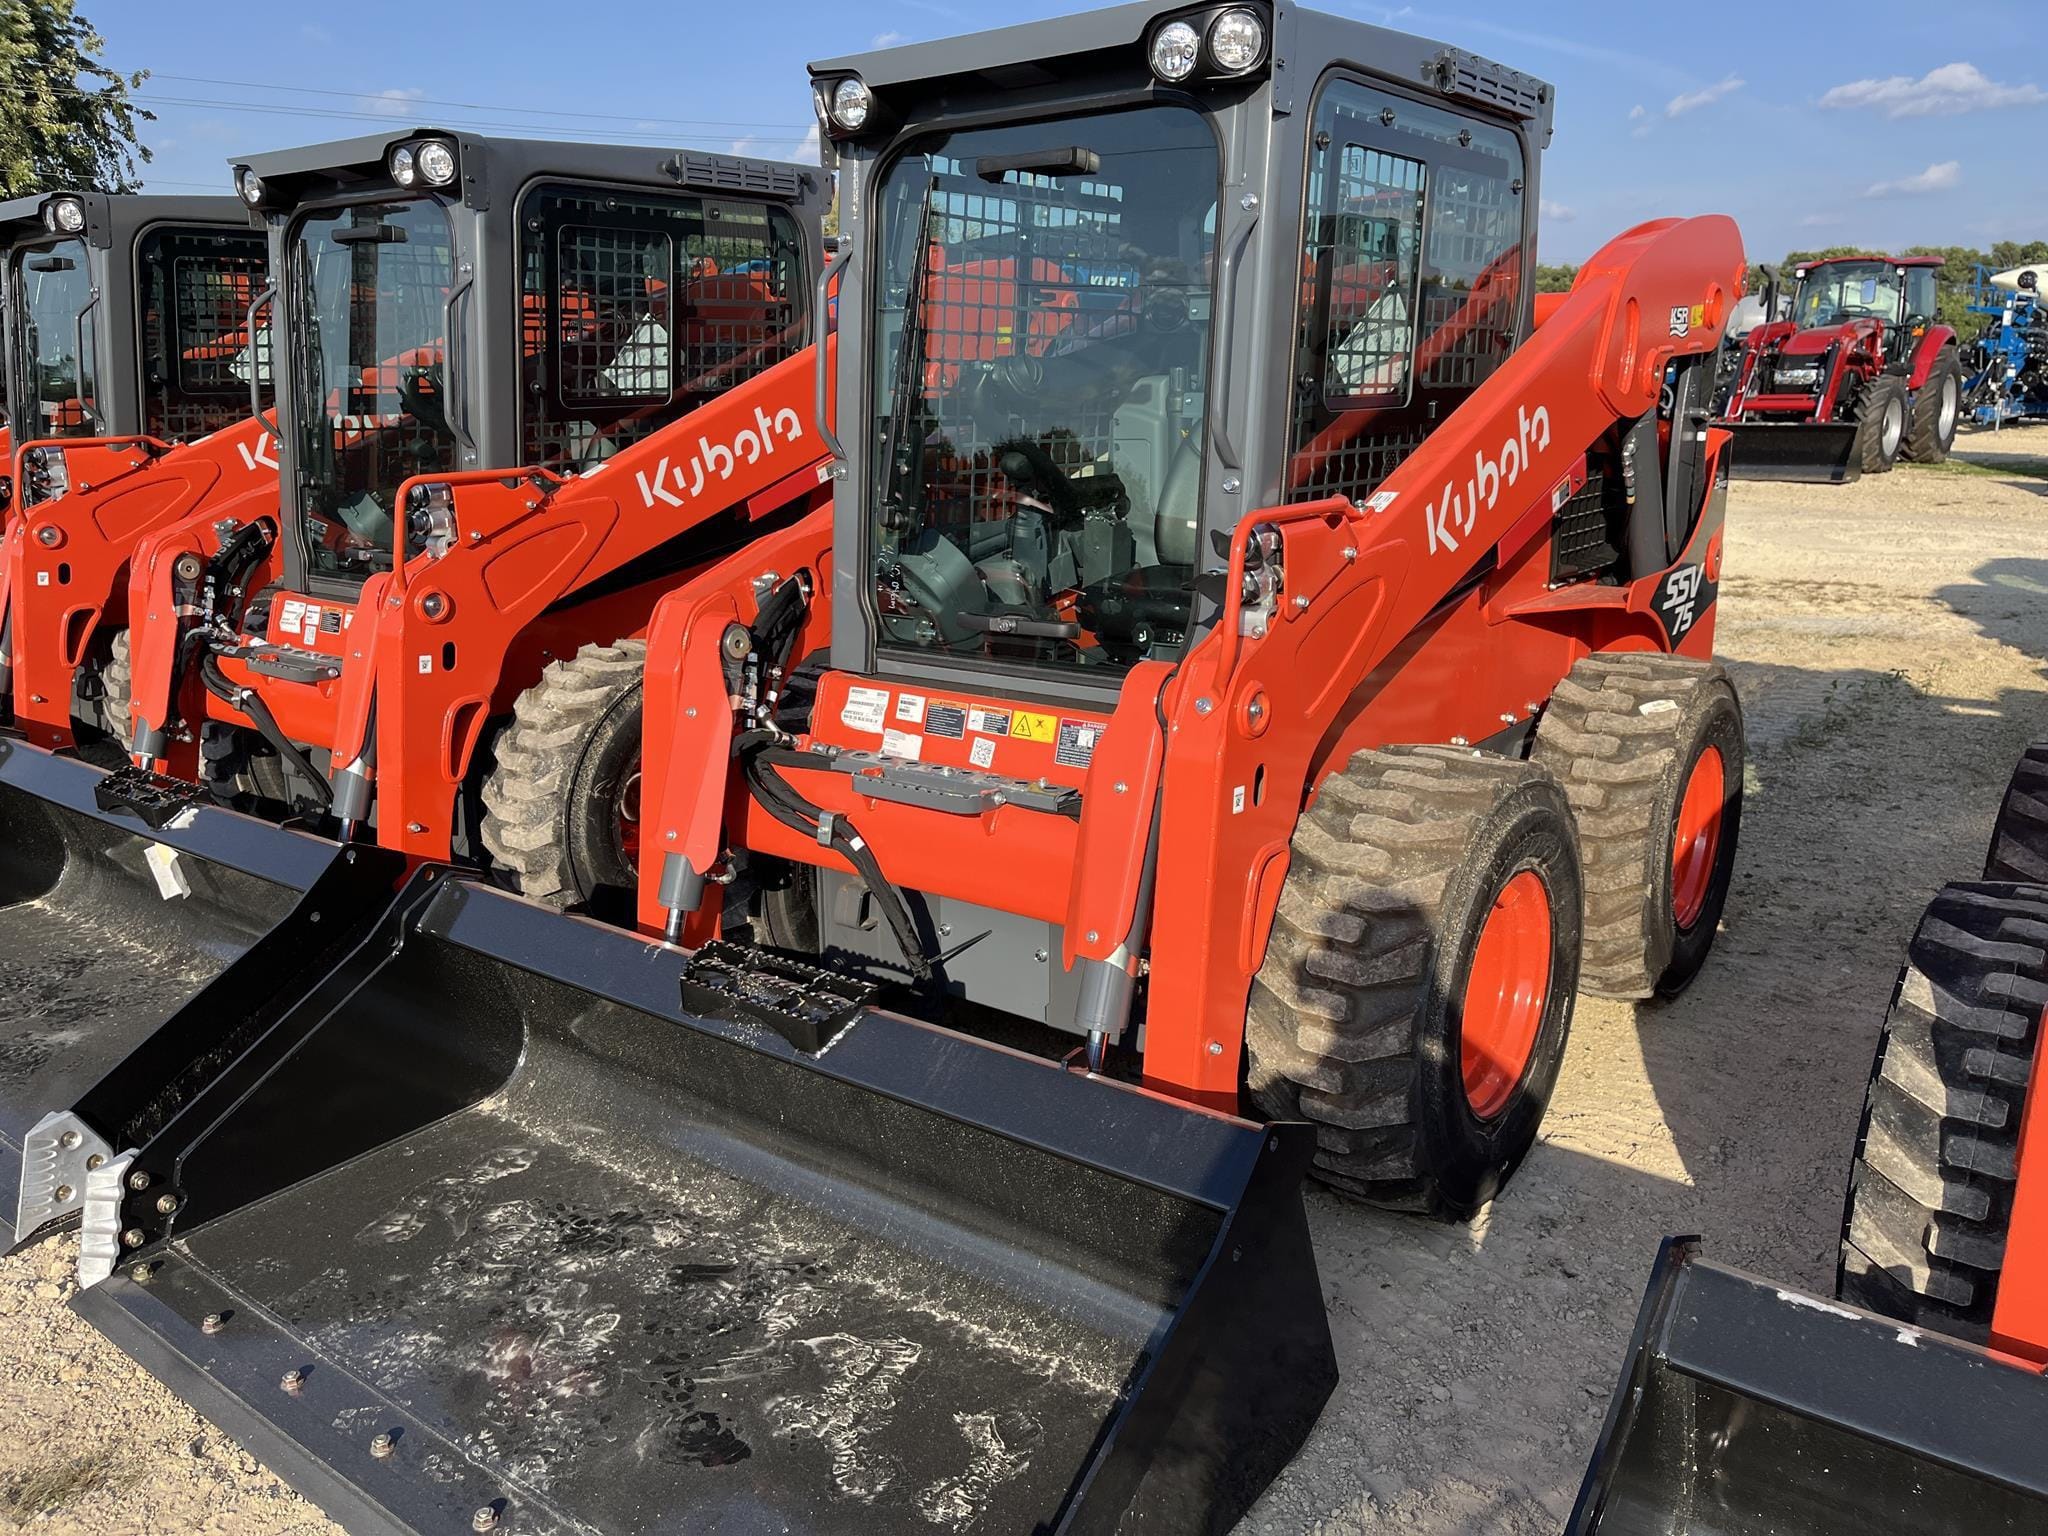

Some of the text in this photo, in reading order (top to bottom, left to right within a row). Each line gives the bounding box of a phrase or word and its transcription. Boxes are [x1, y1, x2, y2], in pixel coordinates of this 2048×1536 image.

[635, 407, 803, 508] Kubota
[1425, 405, 1550, 556] Kubota
[1662, 562, 1705, 610] SSV
[1672, 600, 1695, 636] 75
